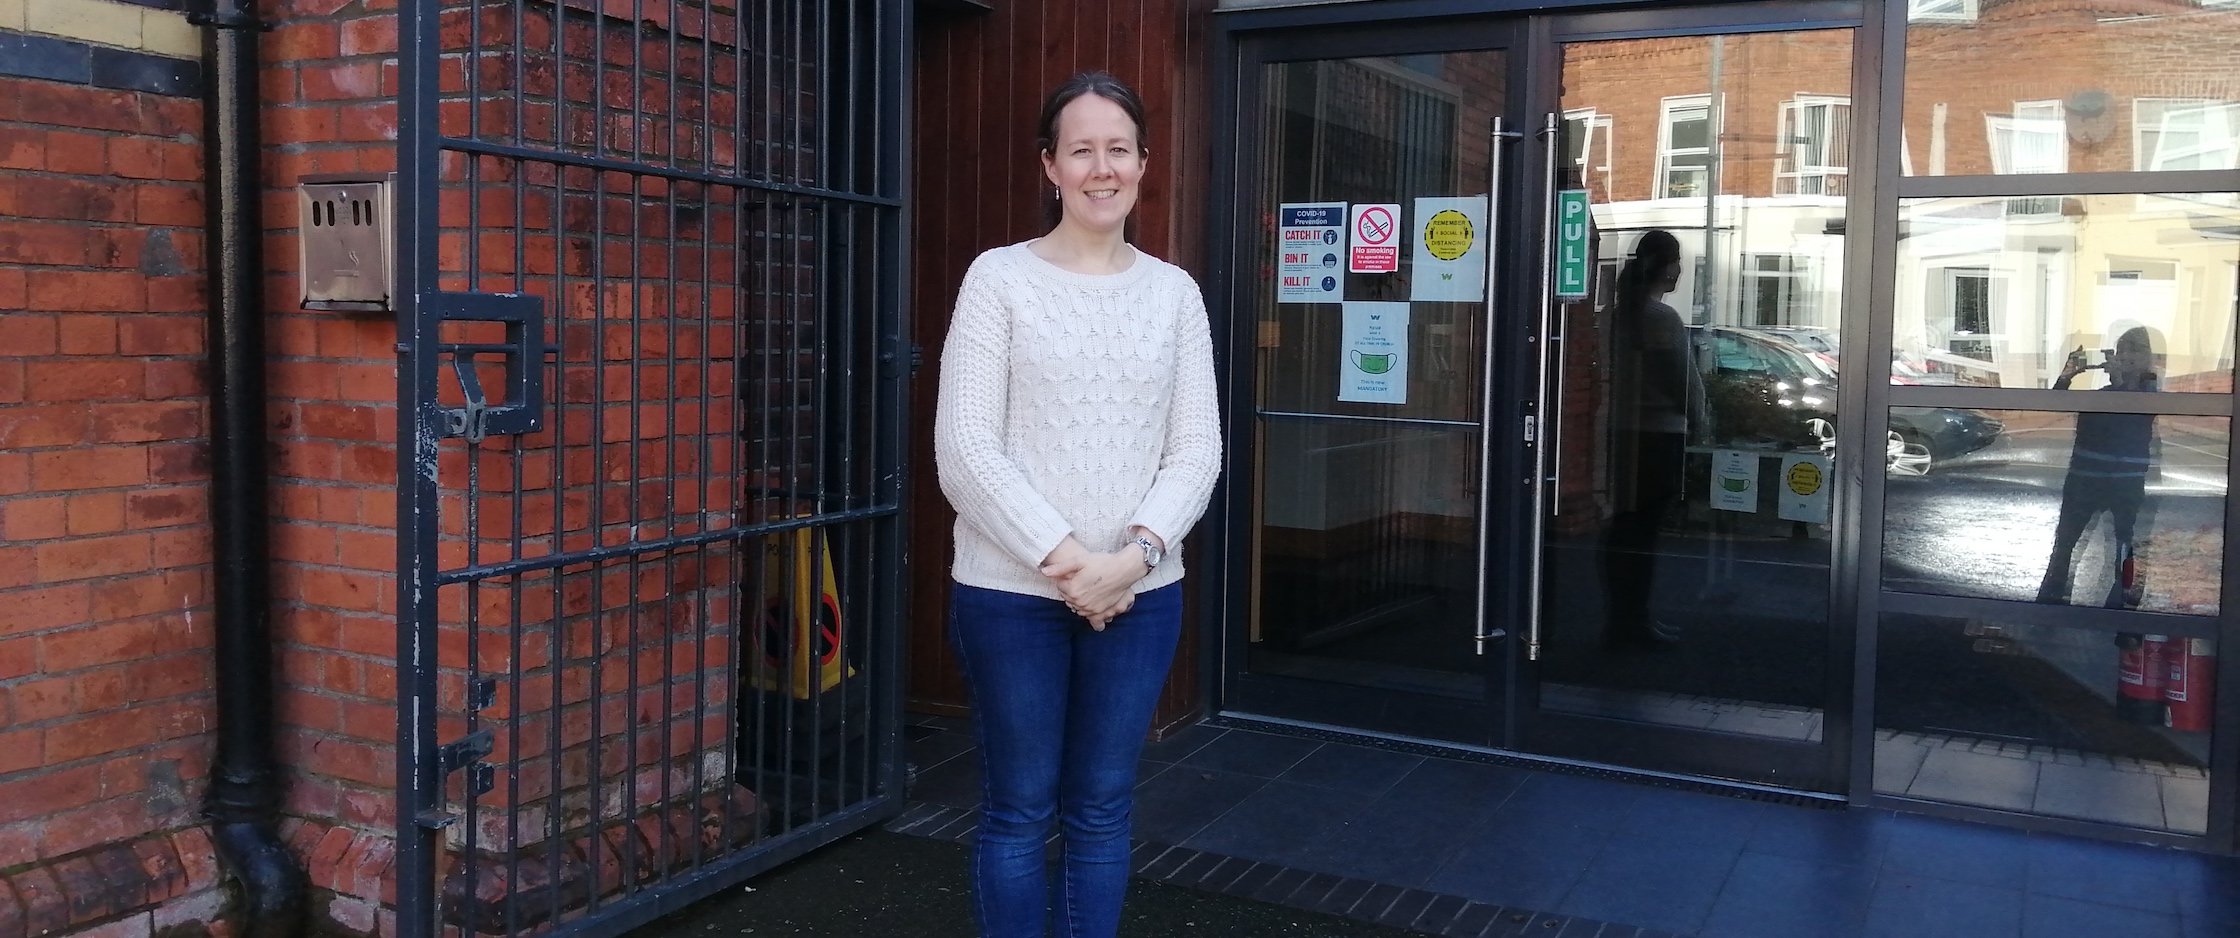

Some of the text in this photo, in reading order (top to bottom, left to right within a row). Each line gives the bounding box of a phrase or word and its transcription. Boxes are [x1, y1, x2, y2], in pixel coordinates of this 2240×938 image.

[1285, 229, 1322, 240] CATCH IT
[1564, 200, 1583, 286] PULL
[1366, 247, 1394, 255] smoking
[1284, 253, 1309, 264] BIN IT
[1283, 276, 1311, 286] KILL IT
